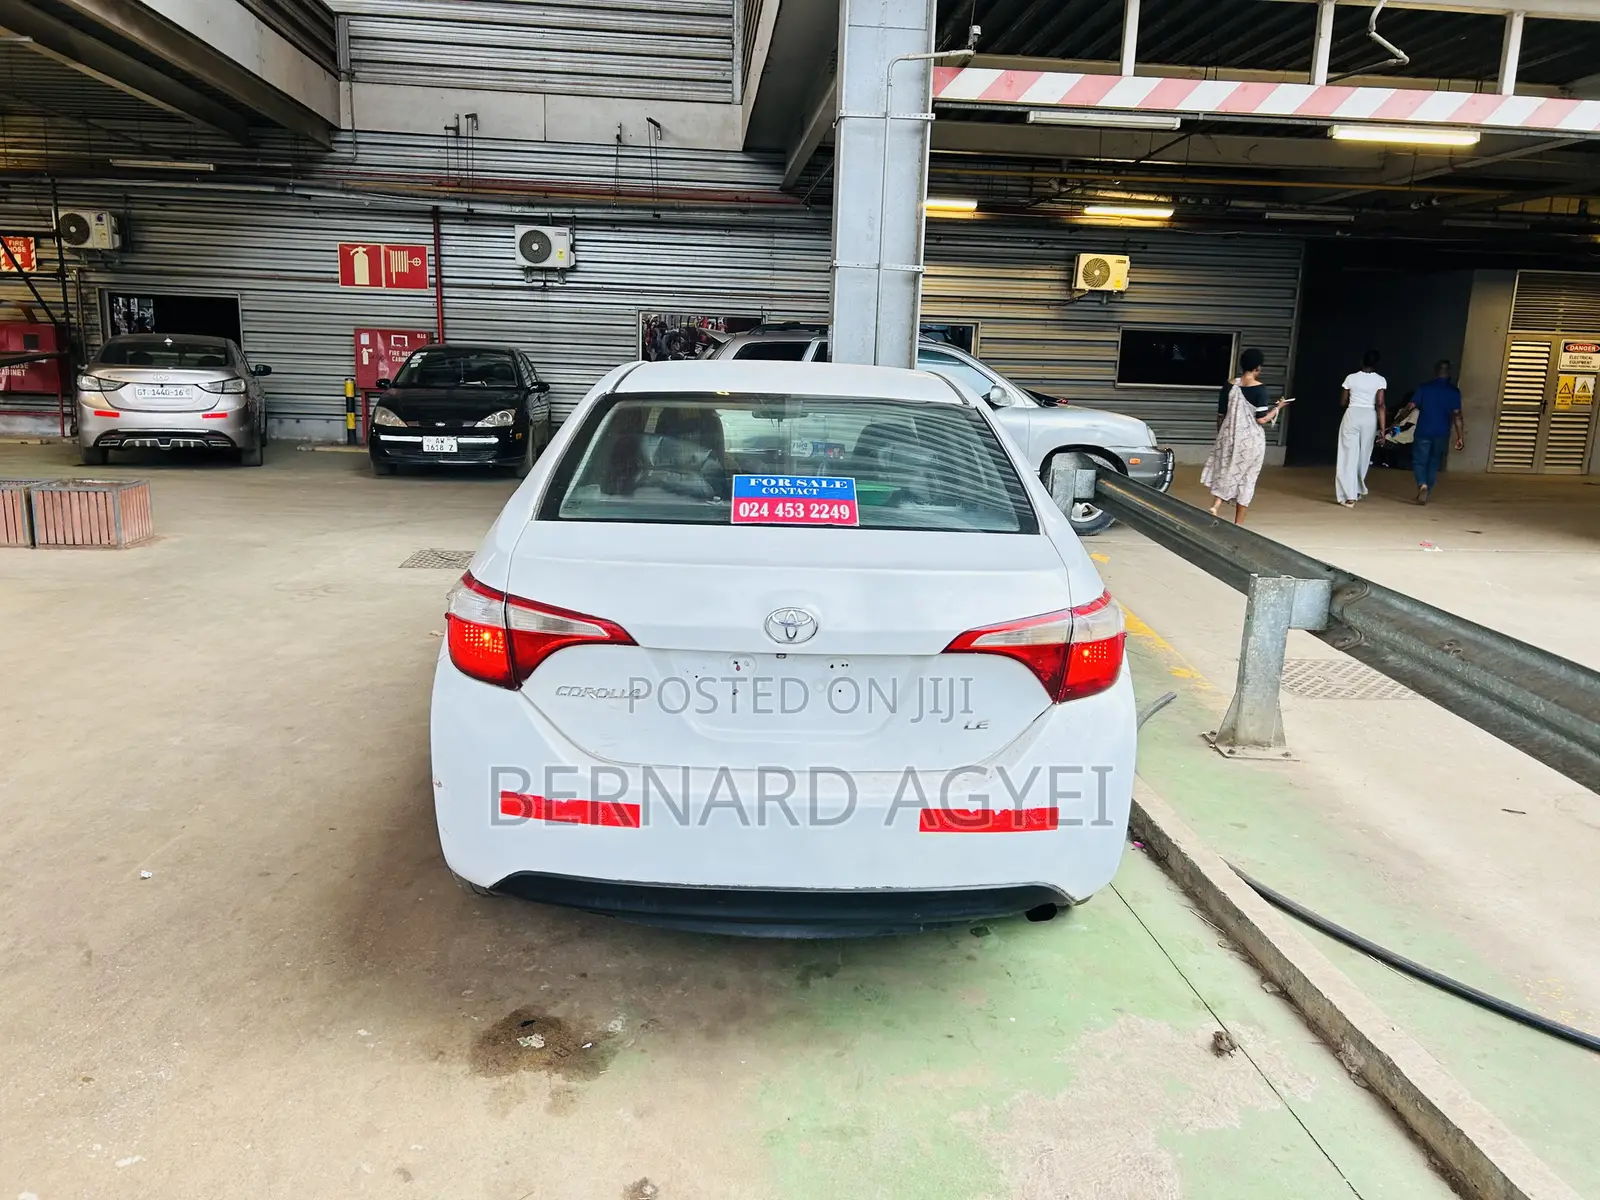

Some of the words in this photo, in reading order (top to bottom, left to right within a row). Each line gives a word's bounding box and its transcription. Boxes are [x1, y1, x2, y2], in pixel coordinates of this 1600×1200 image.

[137, 388, 146, 396] GT
[749, 478, 792, 487] FOR
[796, 479, 848, 489] SALE
[761, 487, 820, 496] CONTACT
[739, 502, 769, 517] 024
[774, 502, 805, 518] 453
[809, 503, 850, 520] 2249
[555, 685, 641, 699] COROLLA
[963, 719, 990, 730] LE
